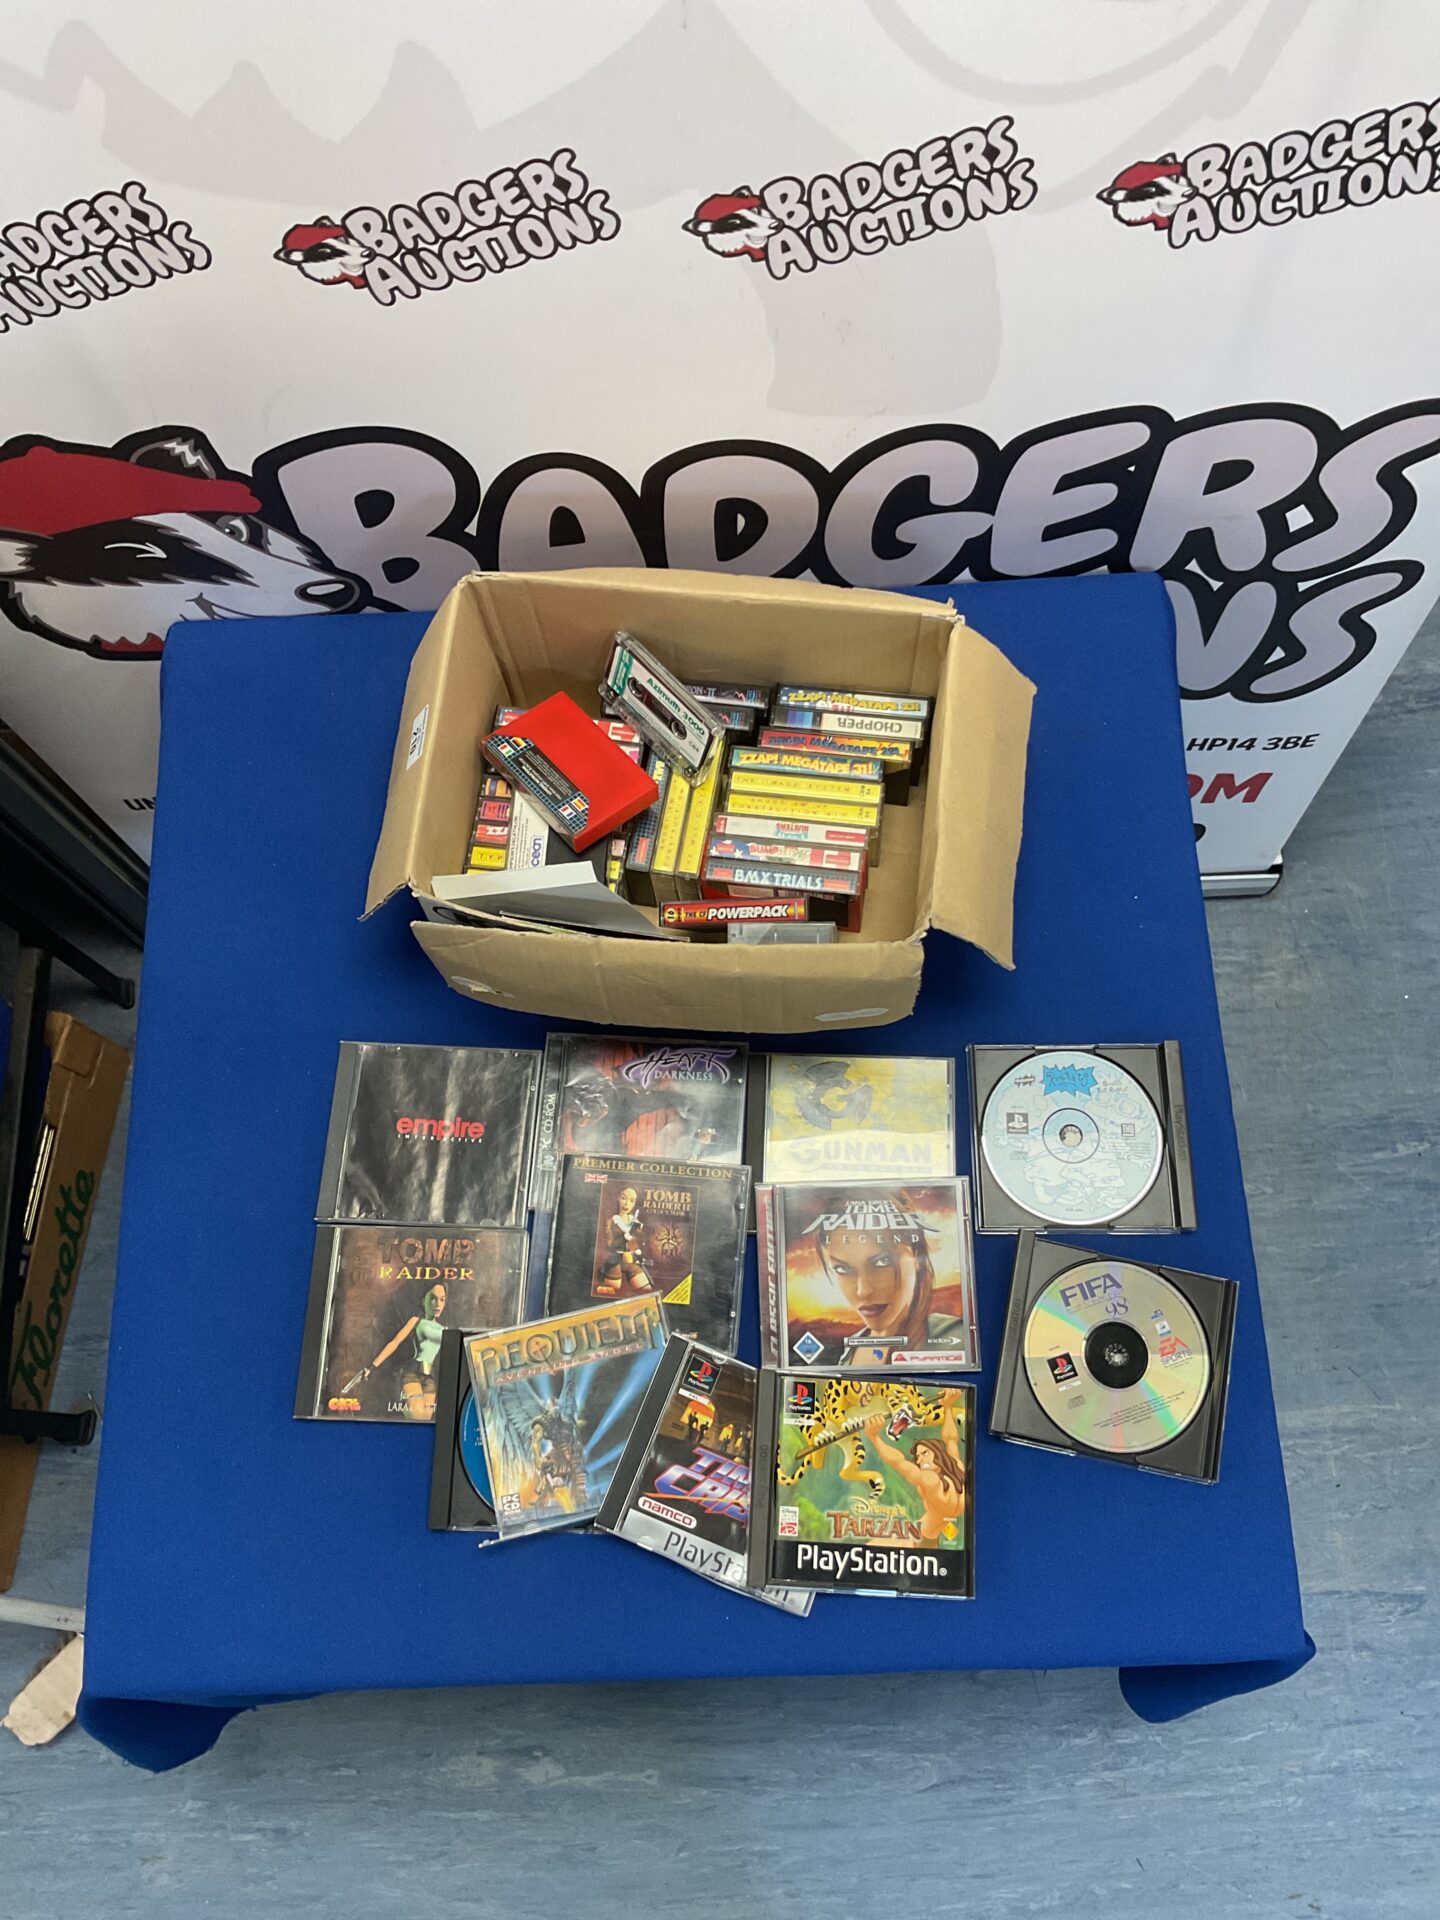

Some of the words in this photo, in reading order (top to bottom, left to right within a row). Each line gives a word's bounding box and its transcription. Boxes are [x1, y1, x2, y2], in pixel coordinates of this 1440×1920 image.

[762, 116, 1017, 230] BADGERS
[342, 148, 588, 256] BADGERS
[1167, 145, 1440, 249] AUCTION
[0, 181, 167, 279] ADGERS
[768, 158, 1037, 280] AUCTIONS
[364, 190, 620, 306] AUCTIONS
[253, 404, 1440, 604] BADGERS
[647, 678, 681, 713] Azimuth
[682, 711, 705, 736] 3000
[831, 692, 897, 711] MEGATAPE
[838, 717, 902, 733] CHOPPER
[1186, 737, 1256, 751] HP14
[1262, 734, 1320, 750] 3BE
[739, 753, 778, 765] ZZAP!
[782, 755, 850, 774] MEGATAPE
[853, 762, 874, 775] 31!
[531, 838, 542, 867] cean
[734, 868, 773, 883] BMX
[774, 873, 822, 889] TRIALS
[708, 904, 789, 921] POWERPACK
[623, 1048, 737, 1089] HEART
[654, 1070, 713, 1081] DARKNESS
[396, 1116, 485, 1142] empire
[789, 1136, 931, 1165] GUNMAN
[573, 1157, 635, 1172] PREMIER
[639, 1163, 733, 1179] COLLECTION
[644, 1189, 691, 1204] TOMB
[845, 1204, 899, 1214] TOMB
[800, 1213, 942, 1235] RAIDER
[377, 1237, 476, 1265] TOMB
[825, 1234, 919, 1245] LEGEND
[378, 1266, 475, 1281] RAIDER
[16, 1169, 95, 1410] Florette
[1059, 1273, 1122, 1308] FIFA
[1105, 1296, 1129, 1316] 98
[477, 1306, 661, 1390] REQUIEM
[589, 1343, 643, 1360] ANGEL
[1160, 1349, 1192, 1366] SPORTS
[388, 1402, 408, 1412] LARA
[690, 1446, 750, 1489] TIM
[502, 1494, 520, 1504] PC
[504, 1502, 520, 1511] CD
[654, 1464, 750, 1528] CRIS
[642, 1497, 694, 1526] namco
[826, 1511, 923, 1541] TARZAN
[663, 1530, 747, 1581] PlaySta
[797, 1544, 939, 1580] PlayStation
